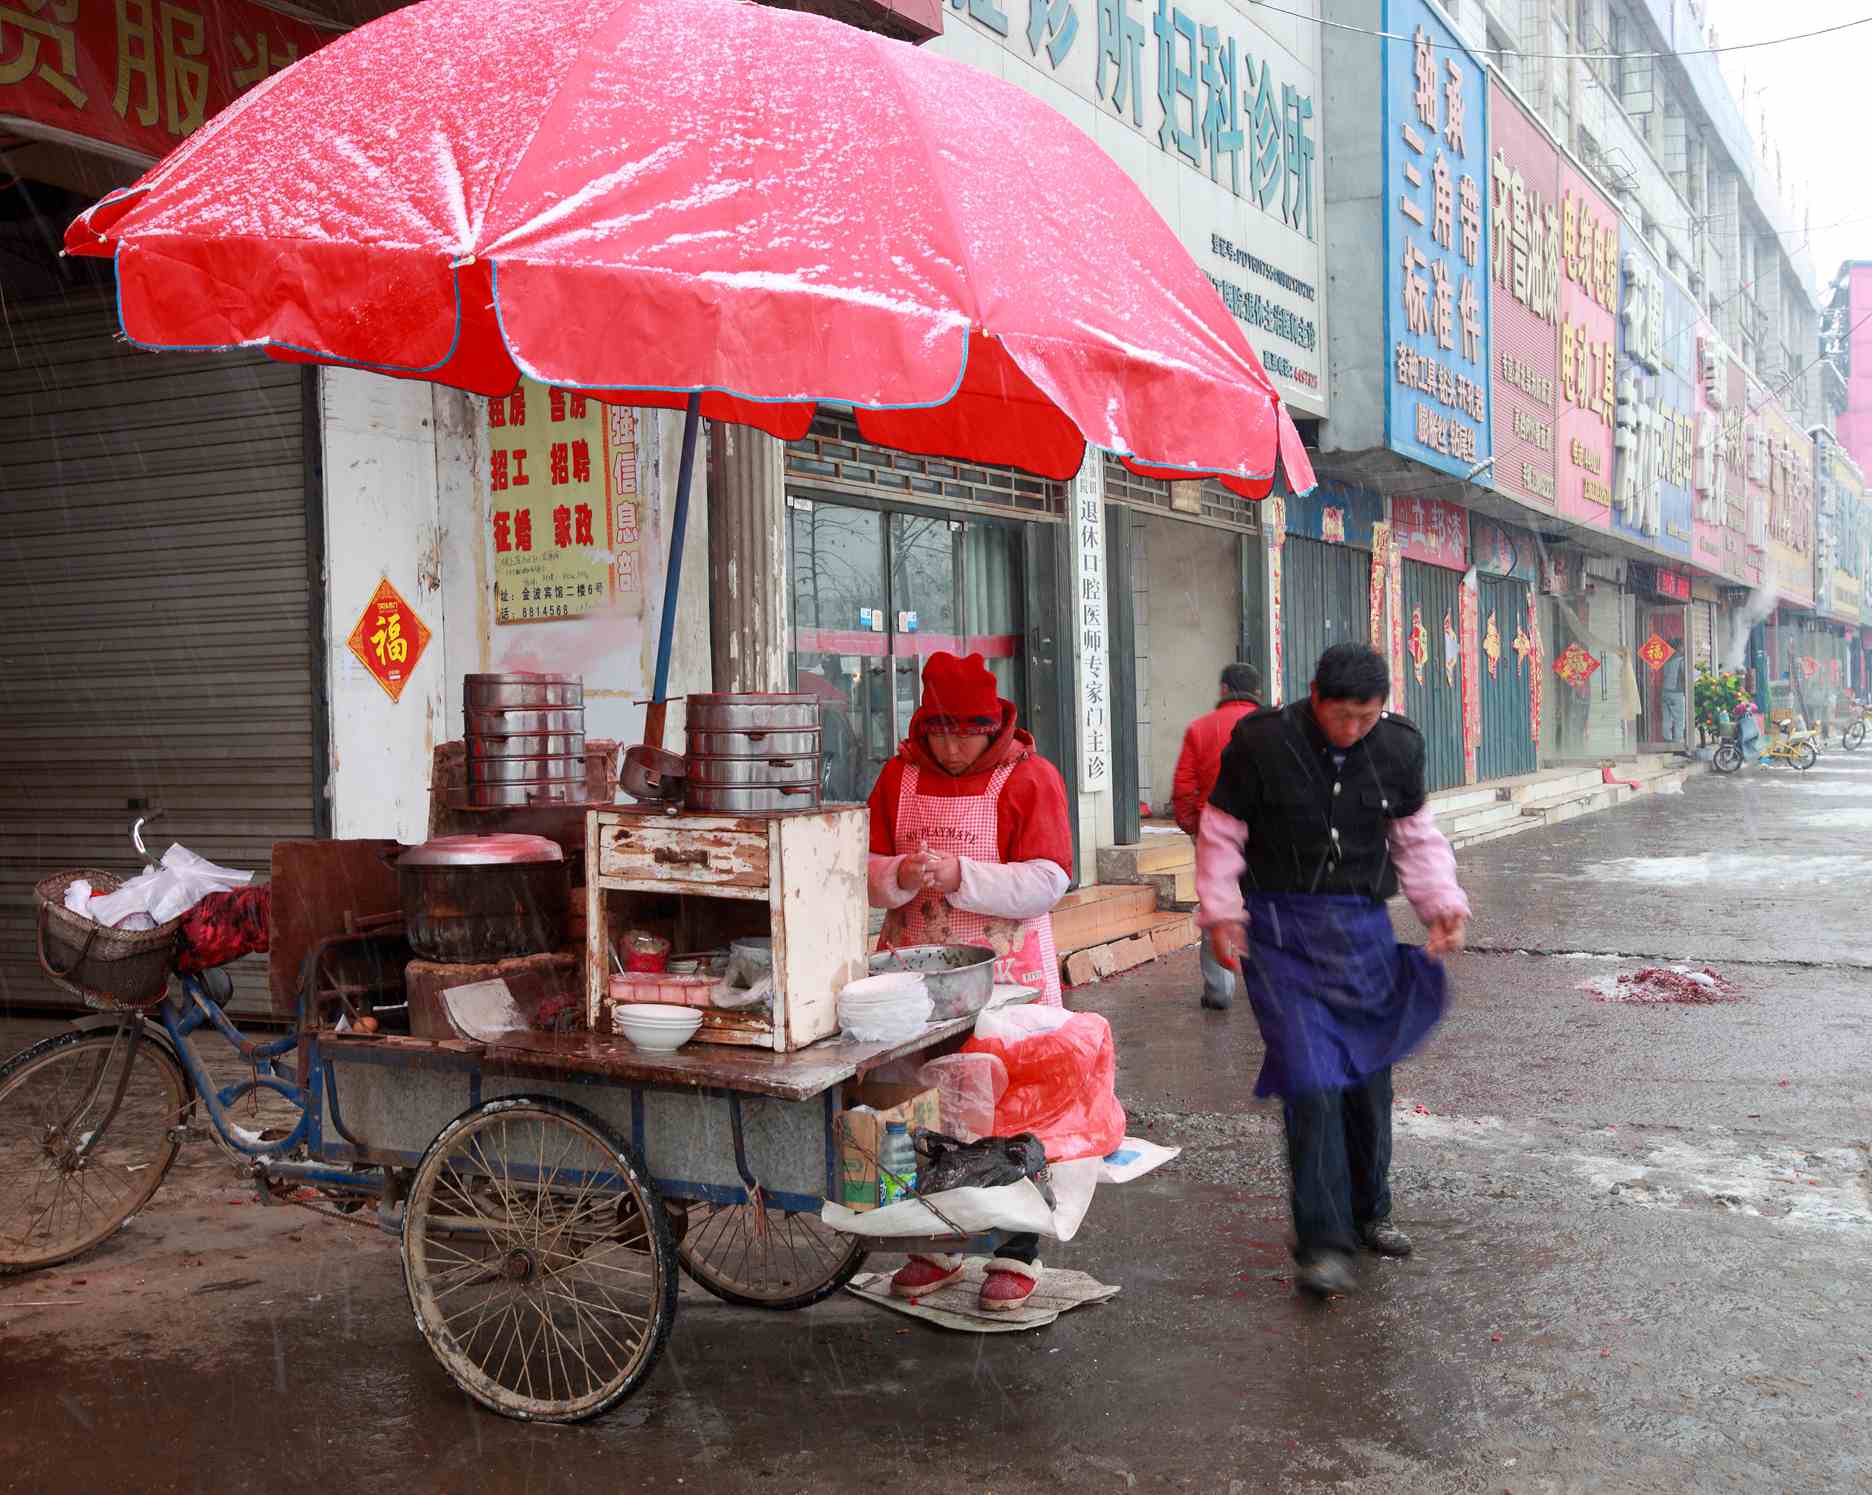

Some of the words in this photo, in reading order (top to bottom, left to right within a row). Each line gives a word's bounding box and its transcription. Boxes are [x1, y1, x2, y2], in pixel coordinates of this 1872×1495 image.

[952, 0, 1315, 239] 所妇科诊所
[1414, 24, 1465, 158] 轴承
[1401, 122, 1481, 267] 三角带
[1492, 147, 1559, 326] 齐鲁油漆
[1402, 236, 1481, 365] 标准件
[1396, 340, 1438, 396] 各种工具
[1560, 318, 1615, 427] 电动工具
[491, 449, 529, 491] 招工
[550, 439, 590, 485] 招聘
[493, 508, 532, 552] 征婚
[553, 502, 594, 548] 家政
[370, 613, 408, 666] 福
